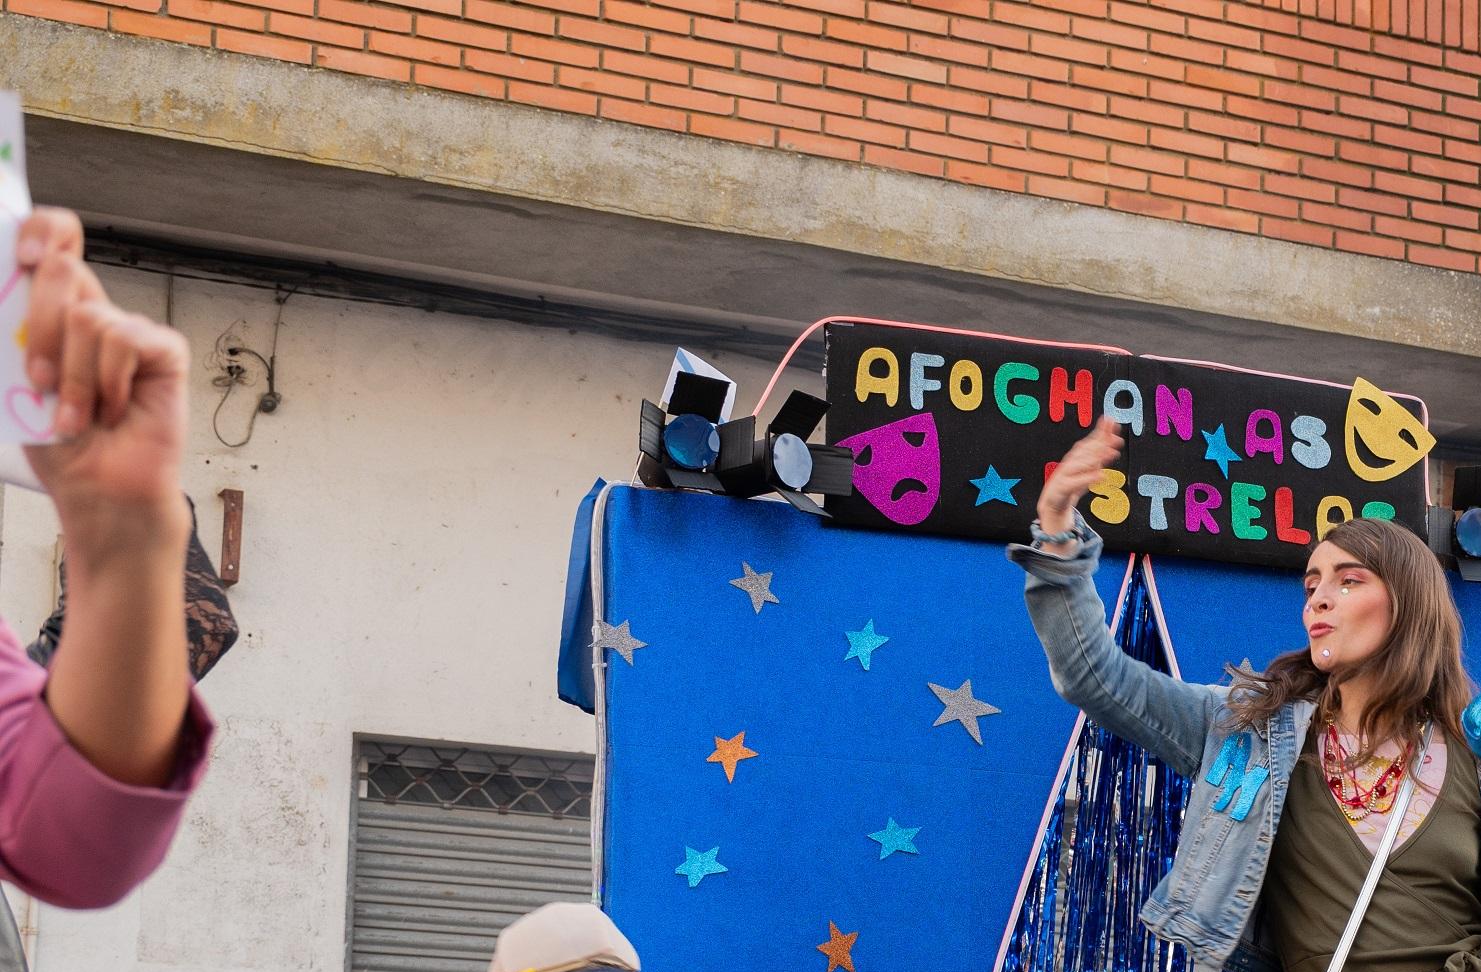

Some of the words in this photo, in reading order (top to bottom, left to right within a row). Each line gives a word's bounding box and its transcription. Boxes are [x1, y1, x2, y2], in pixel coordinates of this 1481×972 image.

[855, 346, 1194, 440] AFOGHAN
[1244, 408, 1331, 469] AS
[1044, 461, 1396, 545] STRELA
